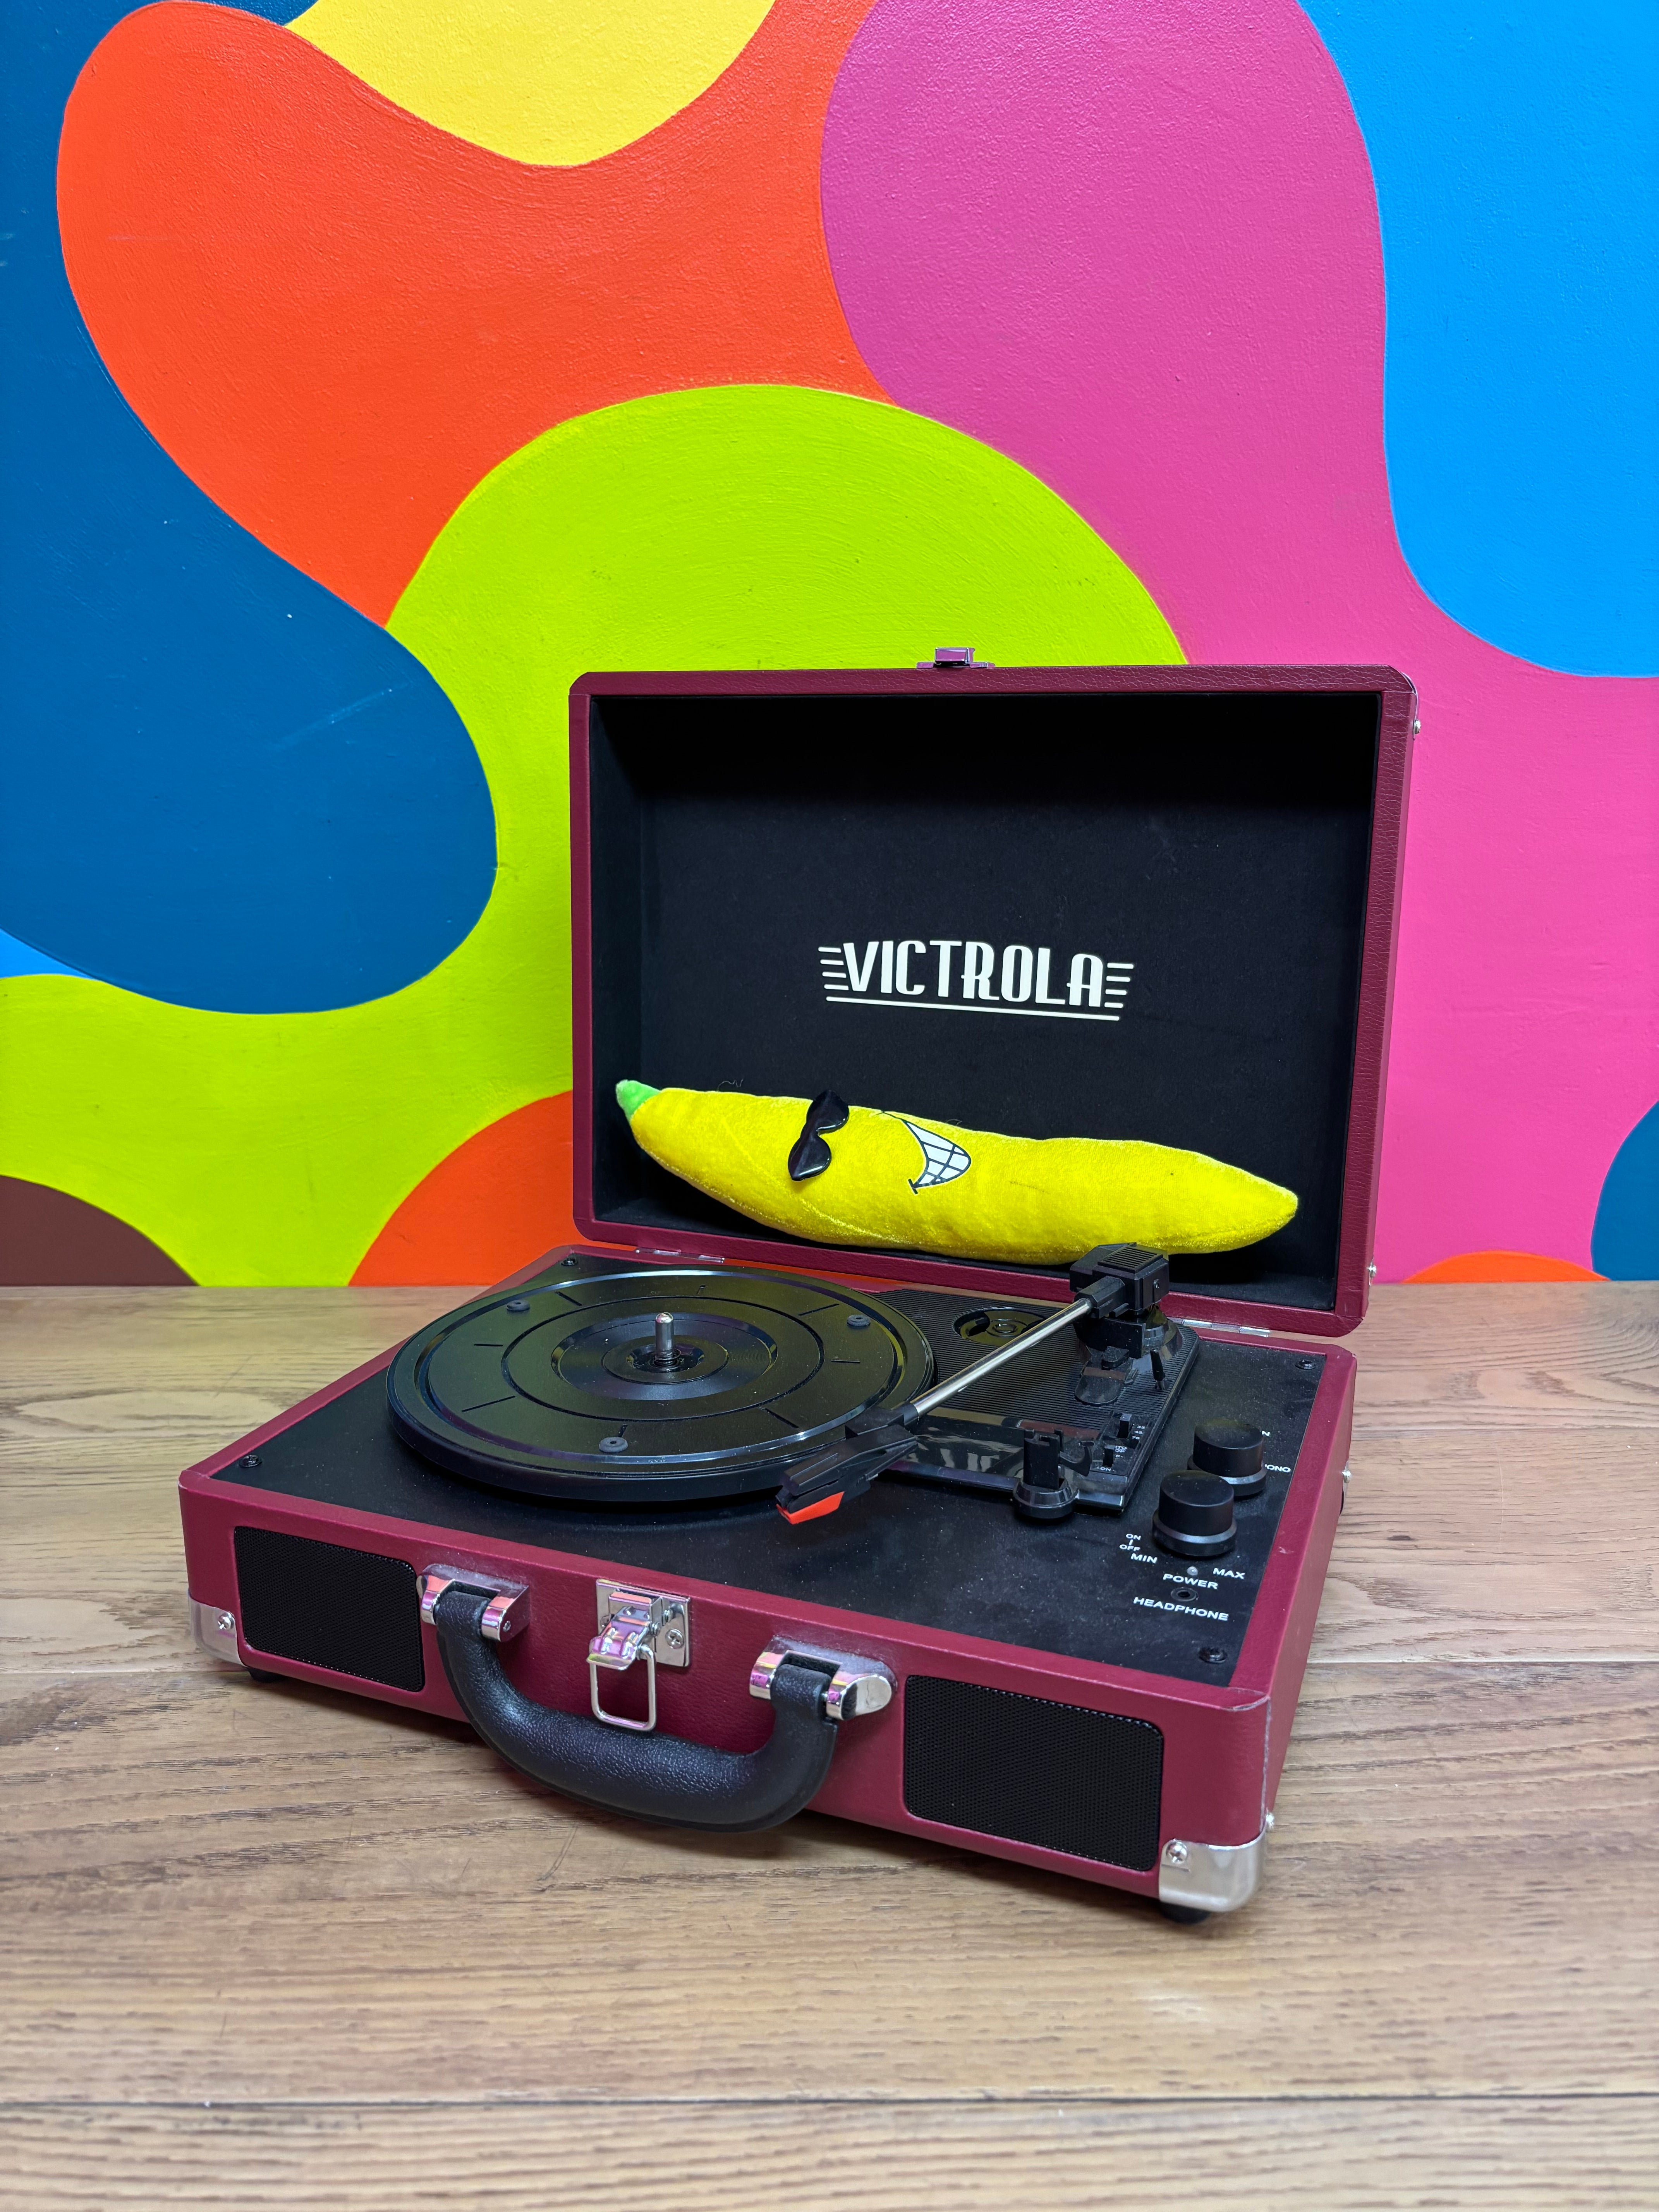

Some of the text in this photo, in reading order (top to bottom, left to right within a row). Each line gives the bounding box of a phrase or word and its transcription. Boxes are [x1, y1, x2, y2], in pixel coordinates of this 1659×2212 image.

[843, 940, 1104, 1007] VICTROLA
[1130, 1553, 1158, 1564] MIN
[1163, 1573, 1218, 1590] POWER
[1213, 1568, 1245, 1579] MAX
[1133, 1597, 1229, 1621] HEADPHONE
